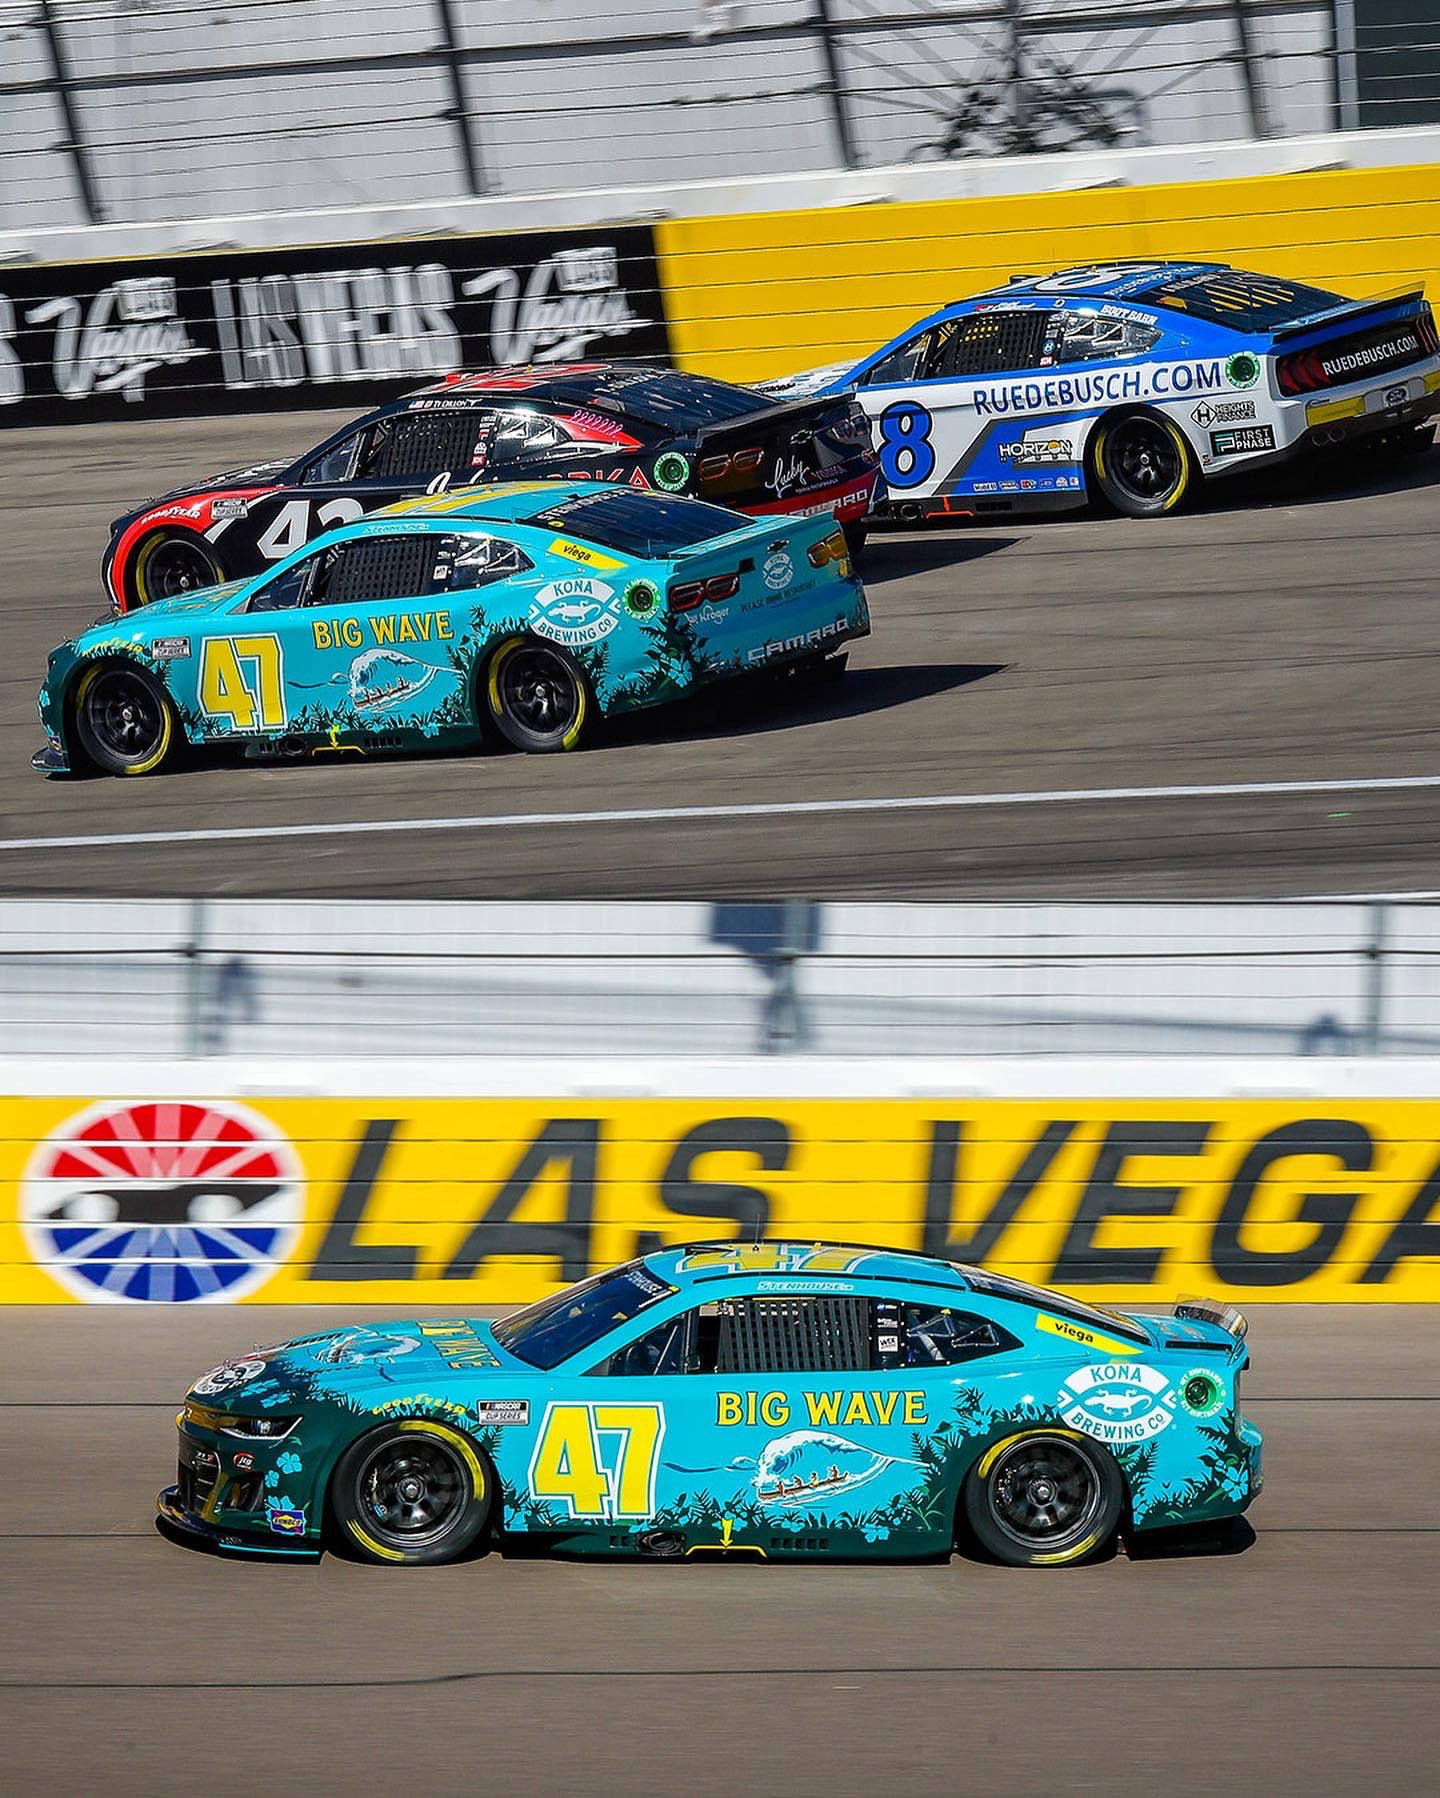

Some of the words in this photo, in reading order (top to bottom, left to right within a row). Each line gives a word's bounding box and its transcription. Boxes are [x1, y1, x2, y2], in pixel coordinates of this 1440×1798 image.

[1321, 335, 1420, 376] RUEDEBUSCH.COM
[973, 362, 1222, 416] RUEDEBUSCH.COM
[879, 401, 936, 490] 8
[1234, 428, 1269, 440] FIRST
[1236, 438, 1272, 450] PHASE
[999, 438, 1072, 458] HORIZON
[563, 543, 592, 561] viega
[553, 580, 593, 597] KONA
[700, 605, 730, 625] Kroger
[312, 617, 364, 650] BIG
[369, 610, 454, 645] WAVE
[537, 622, 597, 642] BREWING
[747, 617, 850, 661] CAMARO
[198, 633, 288, 732] 47
[303, 1117, 794, 1284] LAS
[1055, 1322, 1094, 1344] viega
[1090, 1365, 1143, 1383] KONA
[499, 1412, 521, 1420] SERIES
[715, 1390, 792, 1427] BIG
[802, 1390, 929, 1427] WAVE
[1071, 1412, 1145, 1440] BREWING
[528, 1401, 666, 1520] 47
